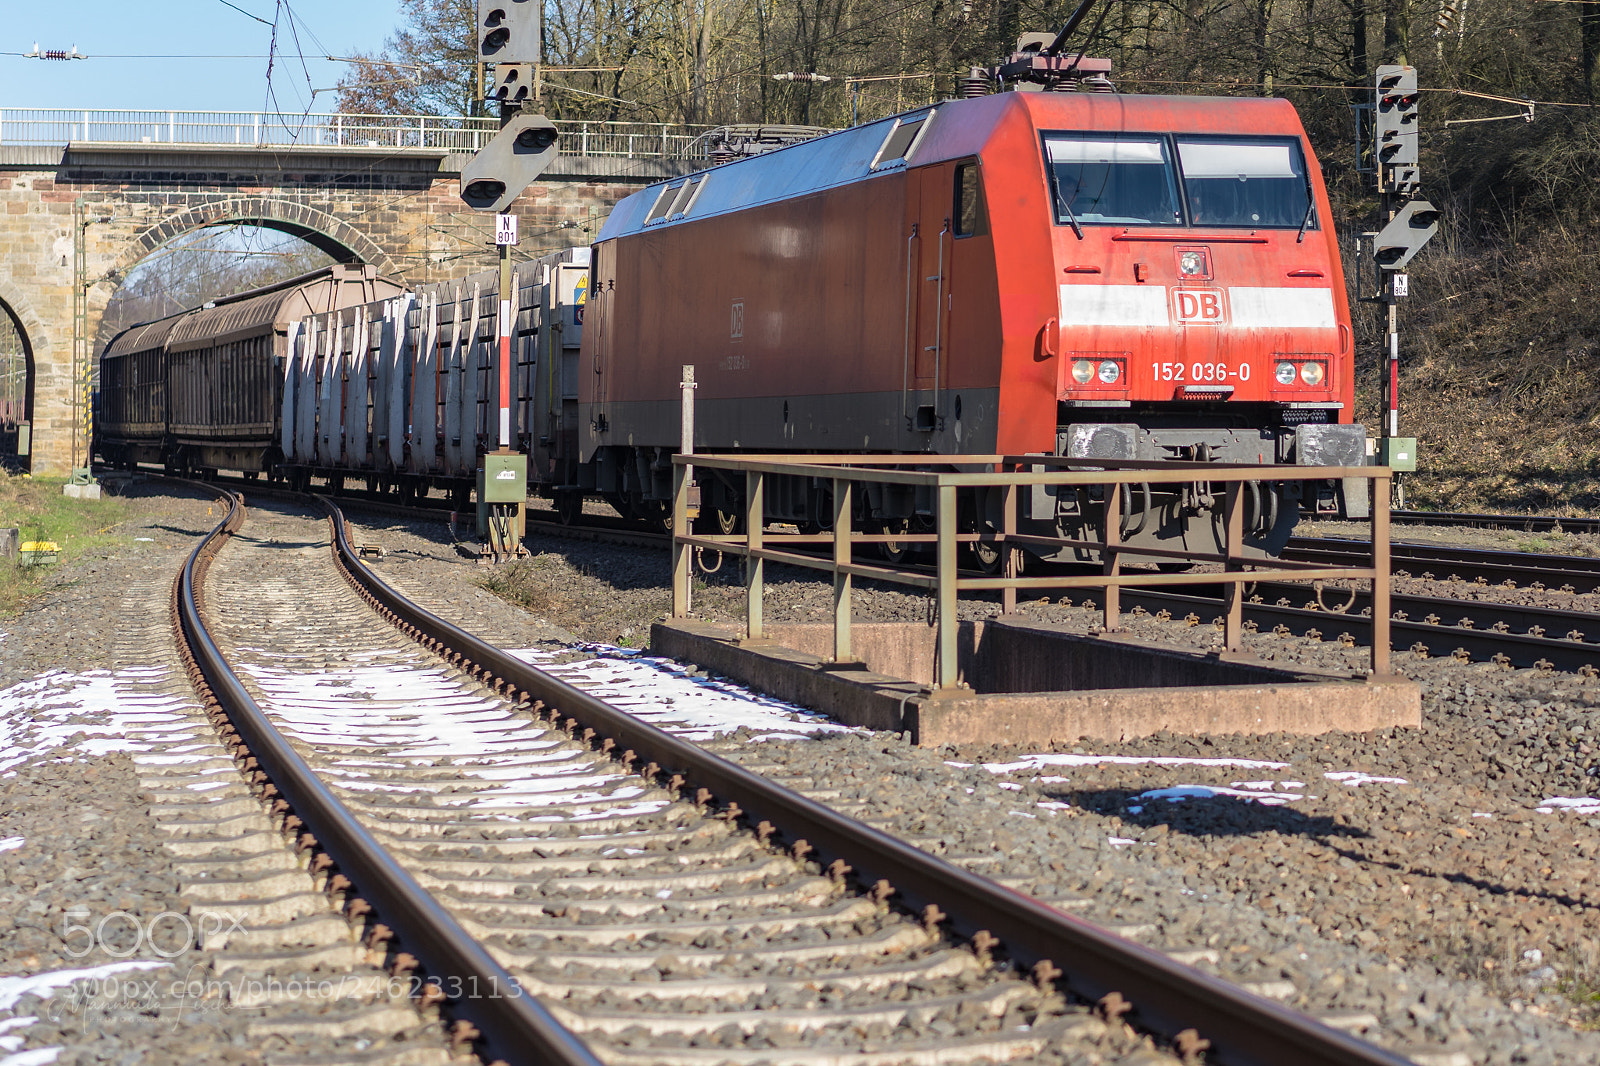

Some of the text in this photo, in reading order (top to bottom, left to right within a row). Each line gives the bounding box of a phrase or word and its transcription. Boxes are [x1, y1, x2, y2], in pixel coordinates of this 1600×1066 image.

[503, 216, 510, 231] N
[498, 231, 515, 243] 801
[1398, 276, 1404, 286] N
[1179, 293, 1221, 319] DB
[731, 303, 744, 338] DB
[1152, 362, 1251, 382] 152 036-0
